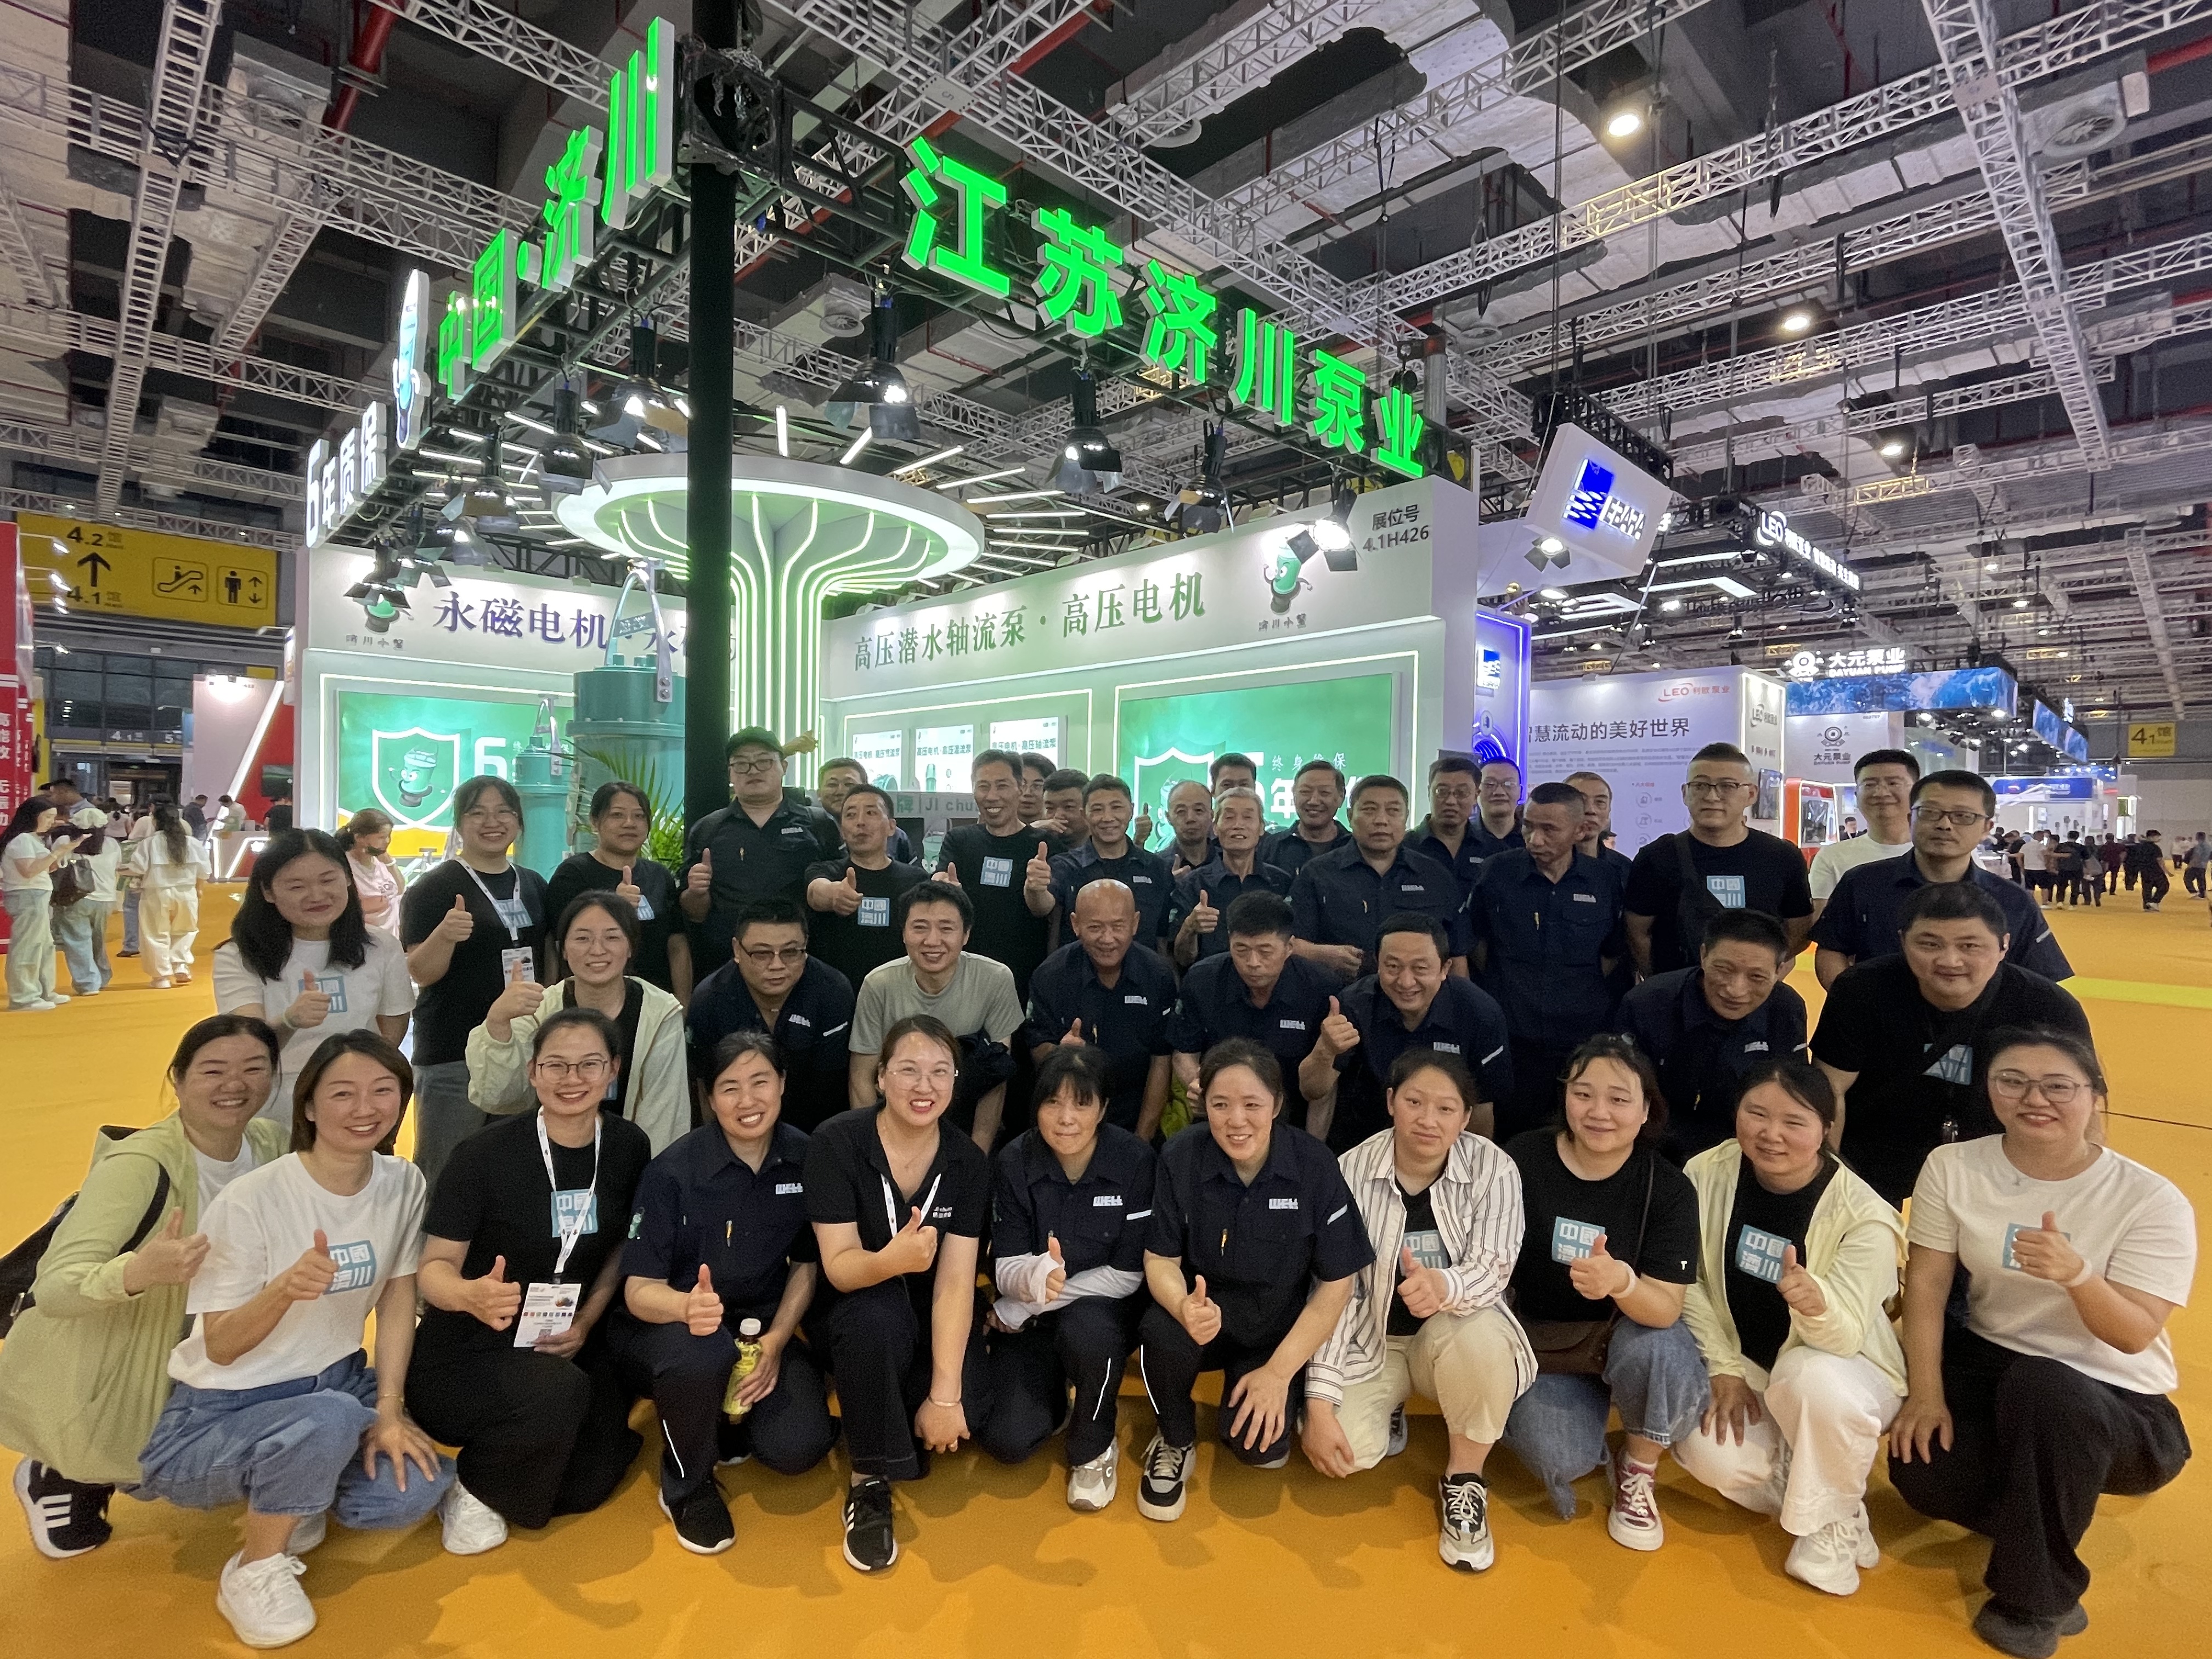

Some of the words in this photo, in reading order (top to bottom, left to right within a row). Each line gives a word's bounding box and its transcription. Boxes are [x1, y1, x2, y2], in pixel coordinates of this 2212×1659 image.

[904, 136, 1424, 478] 江苏济川泵业
[1372, 504, 1420, 531] 展位号
[1762, 511, 1784, 543] LEO
[66, 526, 103, 546] 4.2
[1363, 525, 1430, 552] 4.1H426
[855, 572, 1206, 671] 高压潜水轴流泵·高压电机
[1829, 647, 1905, 668] 大元泵业
[1664, 687, 1690, 697] LEO
[946, 796, 979, 812] chu
